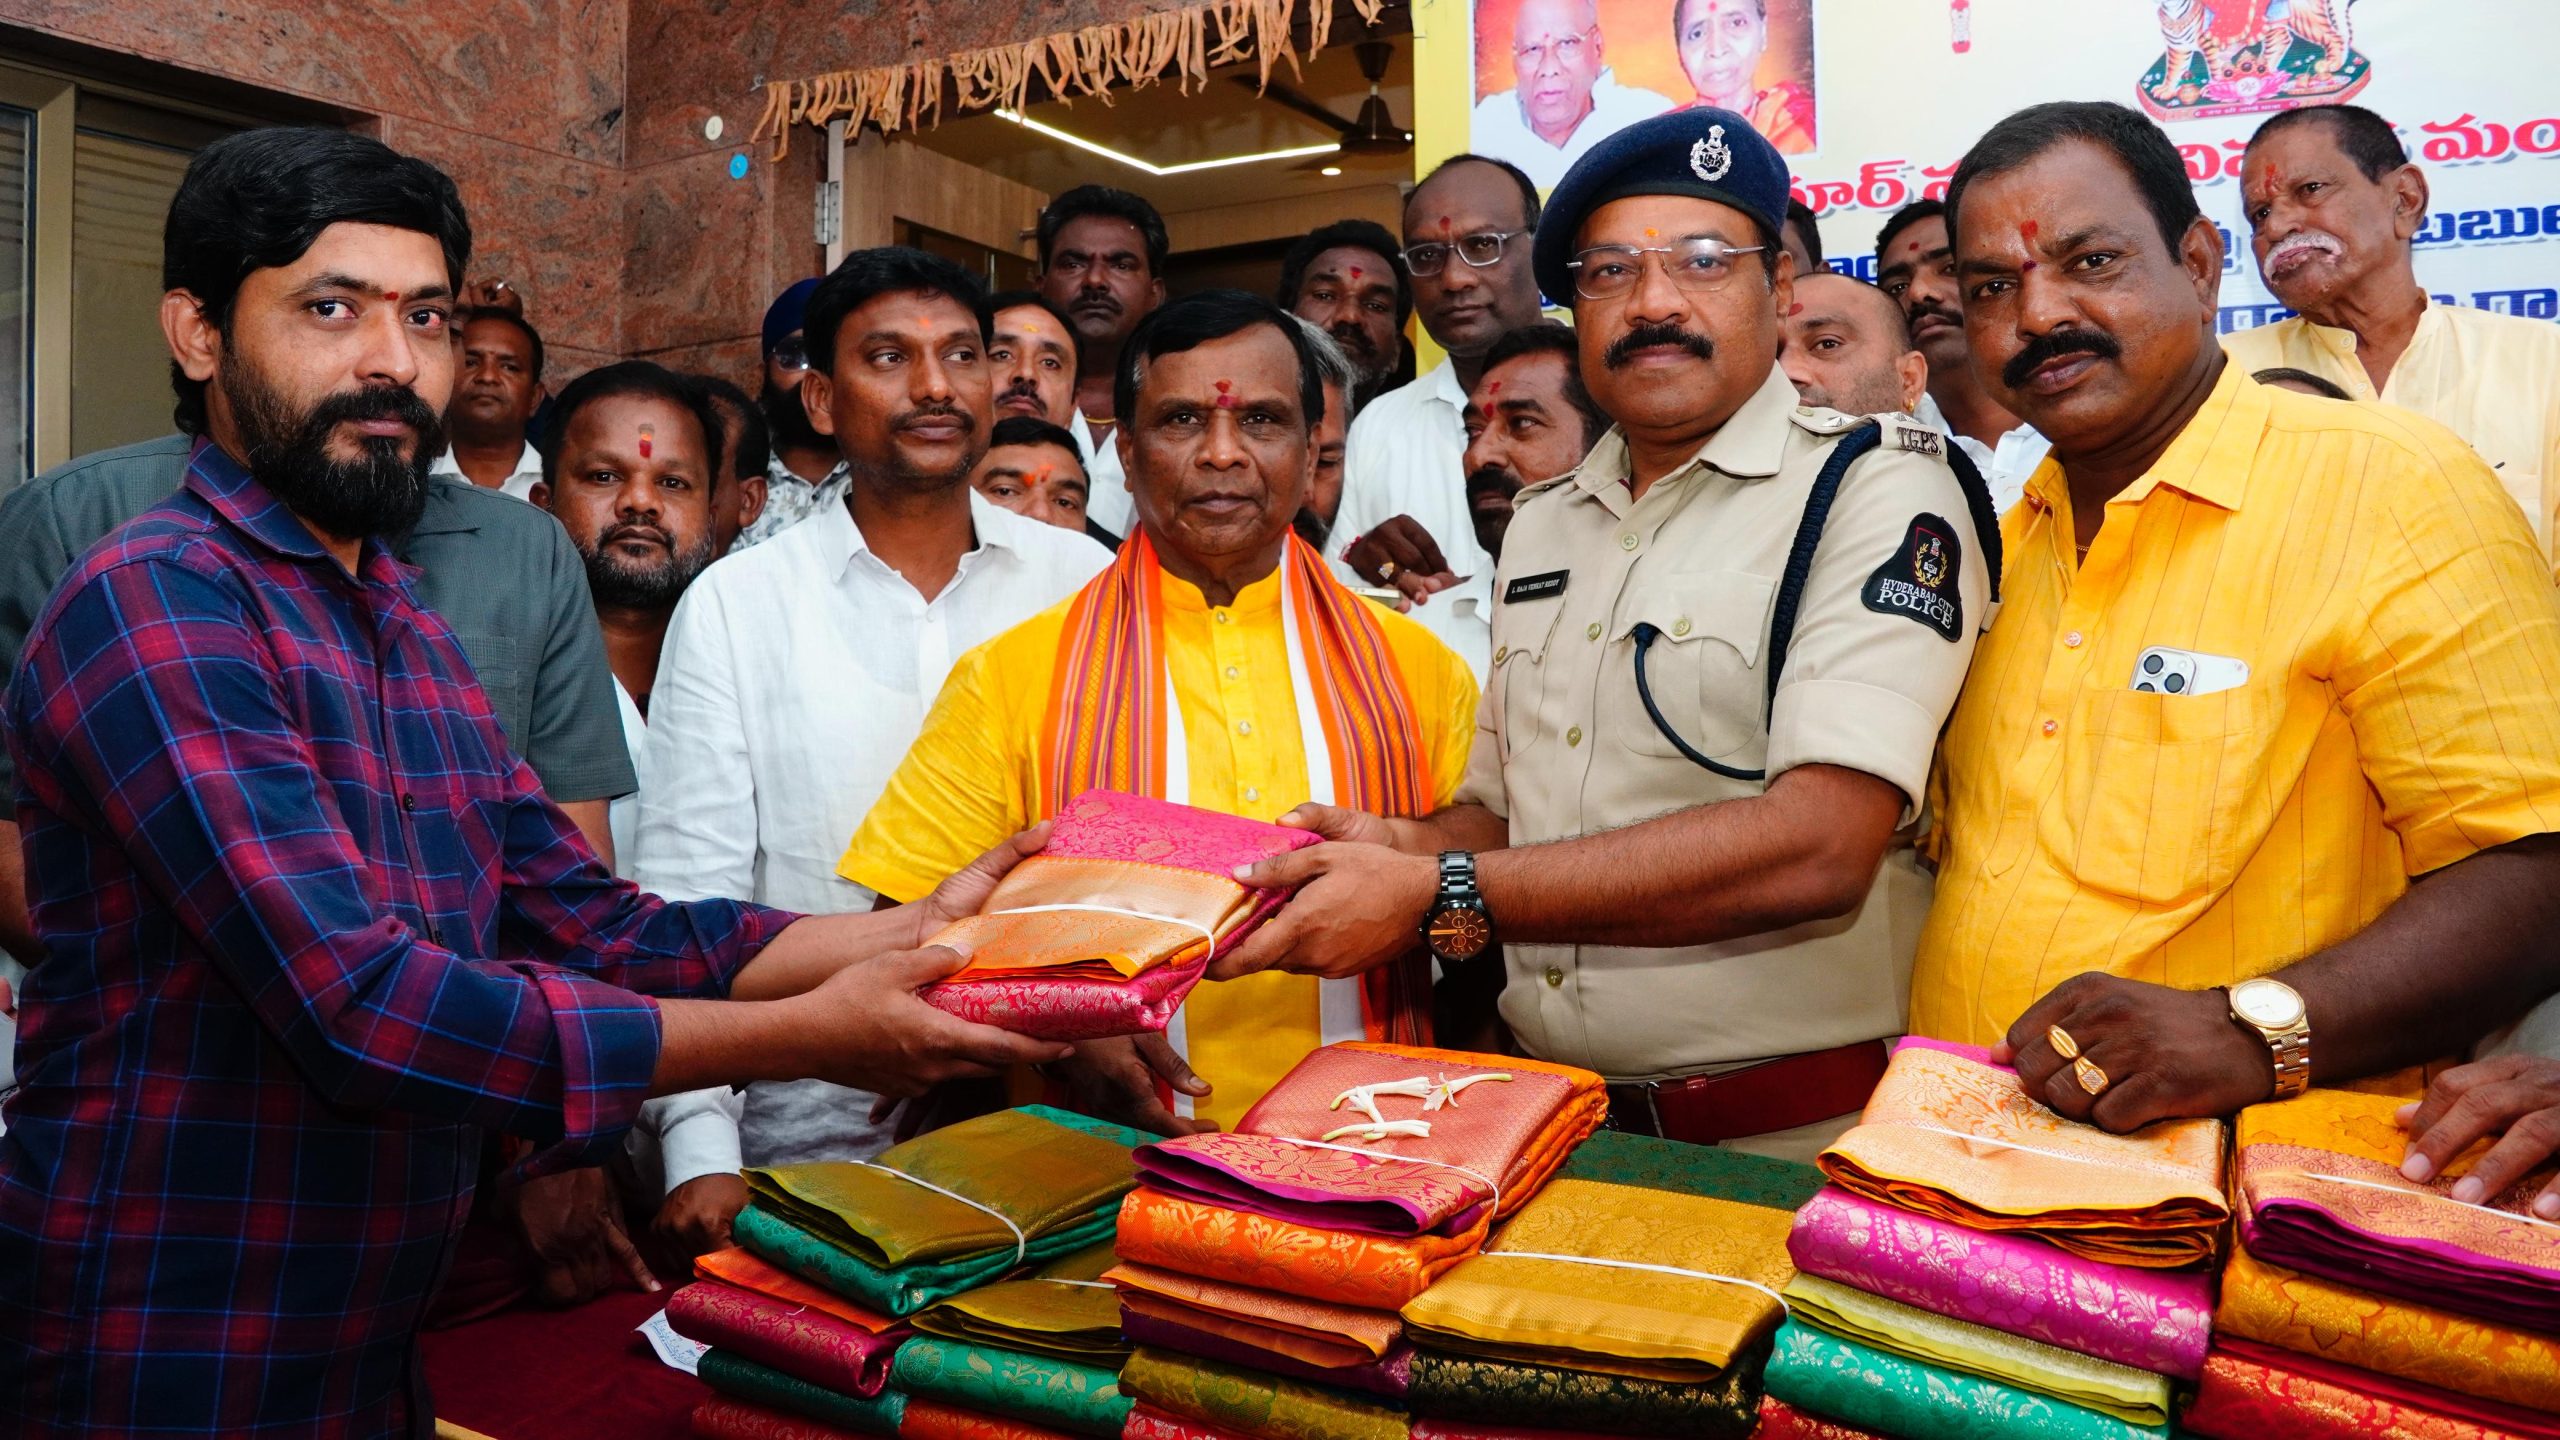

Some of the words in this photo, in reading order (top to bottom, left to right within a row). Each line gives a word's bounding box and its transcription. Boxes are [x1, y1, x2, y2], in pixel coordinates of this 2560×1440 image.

[1876, 588, 1954, 630] POLICE
[1881, 578, 1937, 603] HYDERABAD
[1938, 597, 1955, 617] CITY
